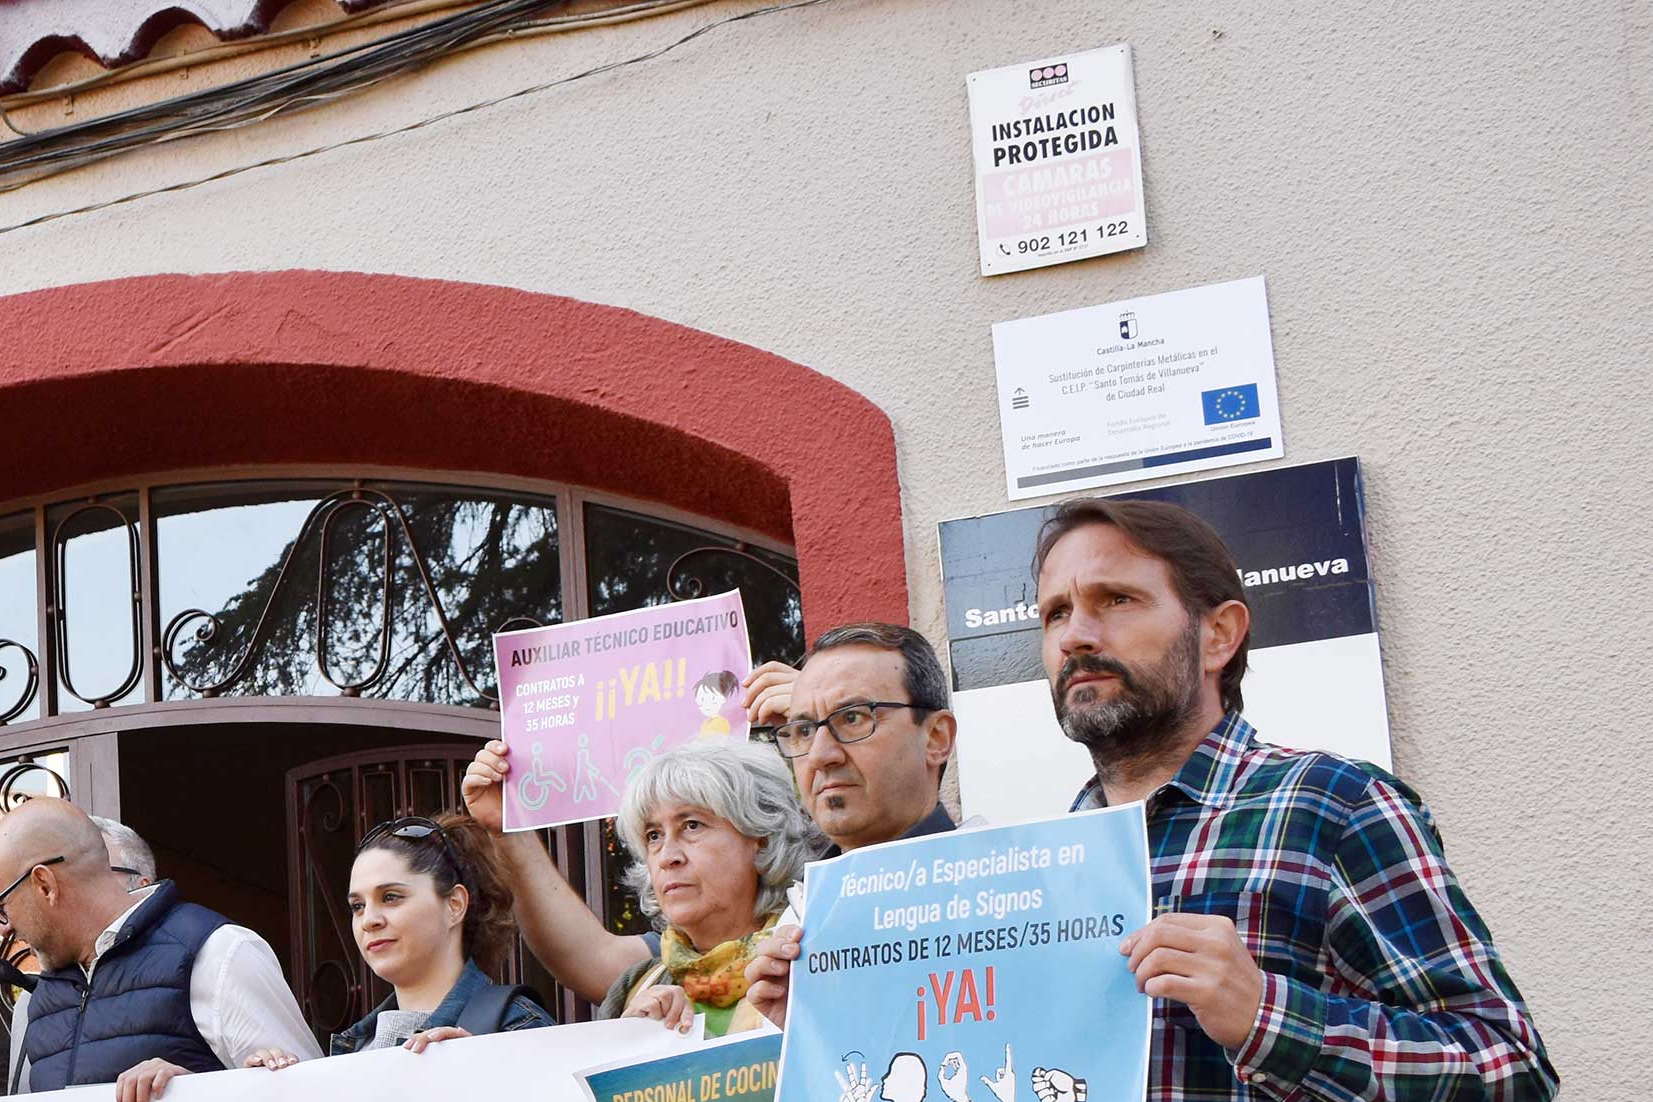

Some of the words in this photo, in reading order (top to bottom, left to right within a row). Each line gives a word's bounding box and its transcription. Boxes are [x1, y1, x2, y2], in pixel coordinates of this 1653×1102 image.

[1031, 76, 1068, 89] SECURITAS
[992, 103, 1115, 141] INSTALACION
[994, 126, 1118, 167] PROTEGIDA
[1005, 157, 1112, 194] CAMARAS
[1008, 179, 1131, 213] VIDEOVIGILANCIA
[1023, 213, 1042, 228] 24
[1048, 202, 1098, 224] HORAS
[1018, 237, 1050, 253] 902
[1058, 229, 1087, 246] 121
[1097, 221, 1128, 238] 122
[1097, 344, 1135, 355] Castilla-La
[1137, 337, 1165, 348] Mancha
[1049, 368, 1093, 383] Sustitución
[1095, 366, 1105, 375] de
[1158, 351, 1196, 366] Metálicas
[1198, 349, 1208, 357] en
[1210, 347, 1218, 355] el
[1119, 374, 1144, 385] Tomás
[1146, 371, 1156, 380] de
[1106, 392, 1116, 402] de
[1118, 387, 1145, 400] Ciudad
[1147, 384, 1165, 394] Real
[1021, 433, 1036, 442] Una
[1037, 430, 1066, 440] manera
[1032, 439, 1052, 449] hacer
[1054, 435, 1081, 447] Europa
[511, 641, 581, 668] AUXILIAR
[584, 626, 648, 654] TÉCNICO
[653, 610, 739, 642] EDUCATIVO
[516, 675, 576, 697] CONTRATOS
[577, 673, 585, 687] A
[595, 657, 688, 721] ¡¡YA!!
[523, 701, 535, 715] 12
[536, 697, 571, 712] MESES
[572, 696, 580, 710] y
[526, 718, 539, 732] 35
[540, 713, 575, 729] HORAS
[839, 859, 926, 898] Técnico/a
[932, 846, 1051, 886] Especialista
[1058, 843, 1085, 865] en
[873, 901, 940, 936] Lengua
[946, 893, 971, 920] de
[976, 886, 1043, 923] Signos
[808, 941, 902, 975] CONTRATOS
[907, 938, 929, 961] DE
[934, 935, 951, 957] 12
[957, 921, 1051, 956] MESES/35
[1057, 913, 1124, 943] HORAS
[916, 965, 996, 1041] ¡YA!
[700, 1072, 722, 1102] DE
